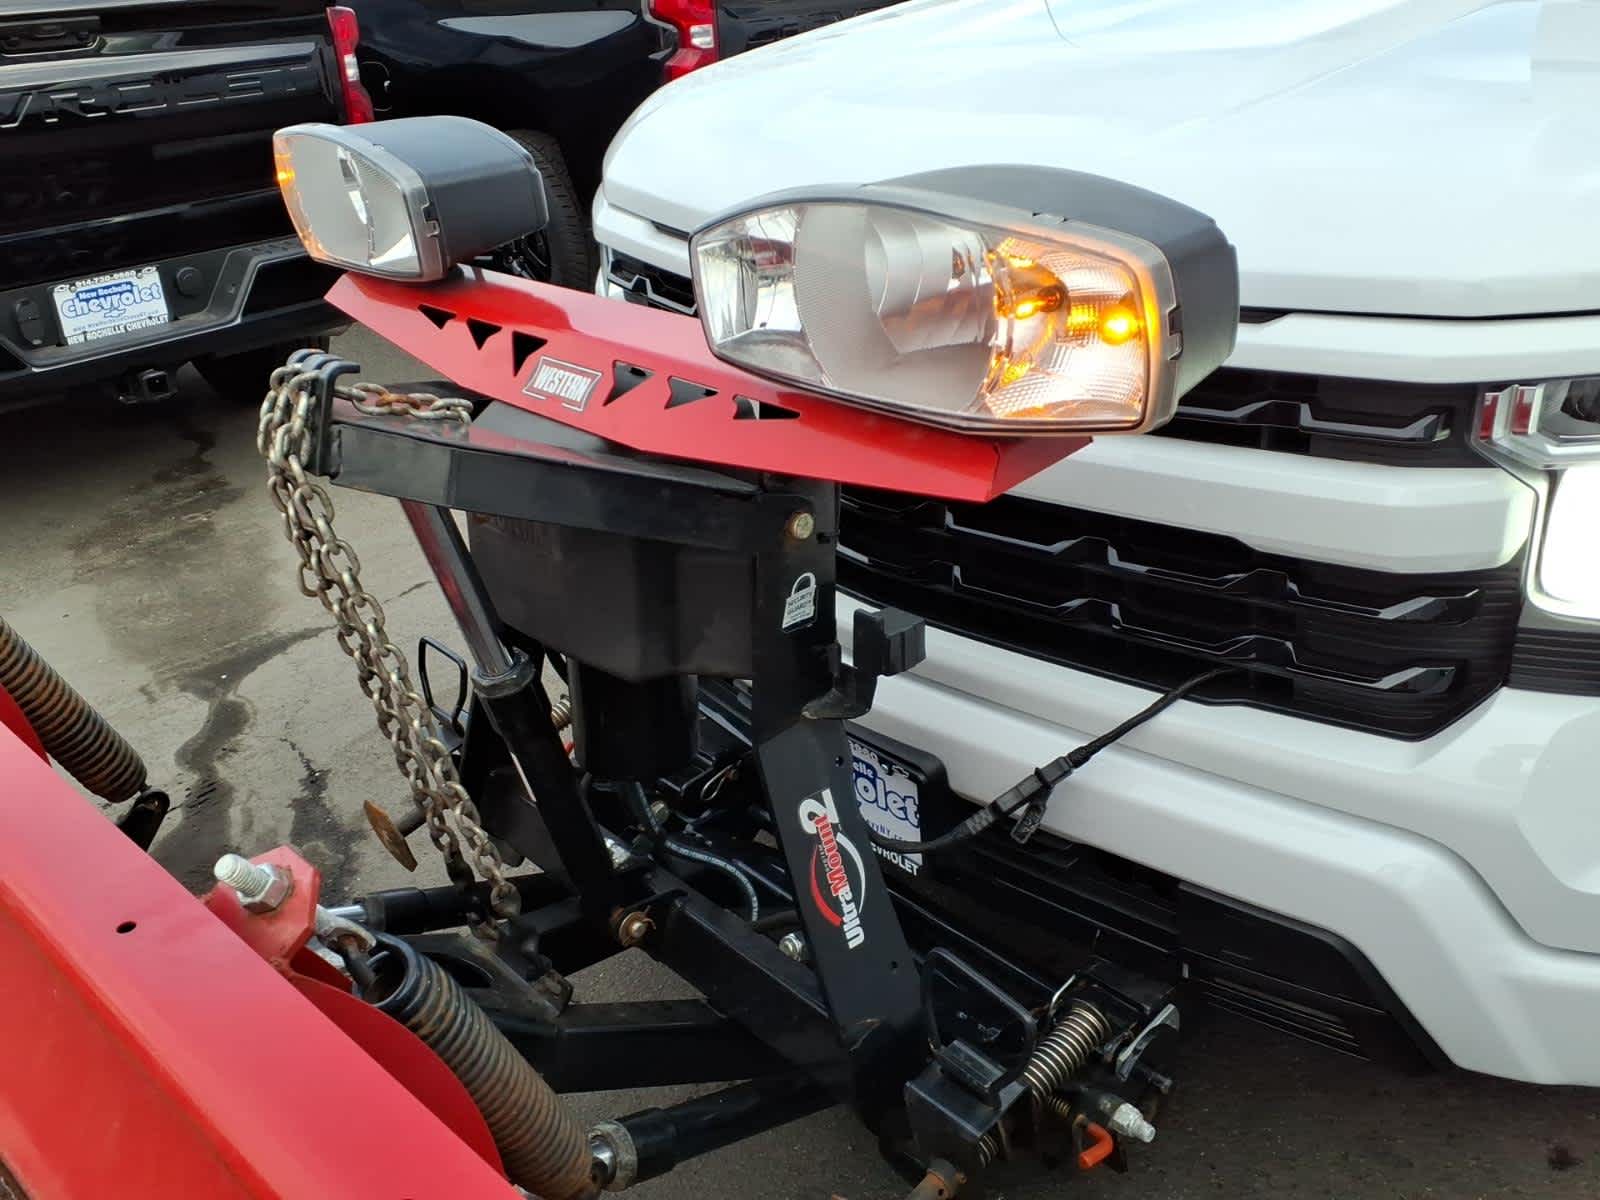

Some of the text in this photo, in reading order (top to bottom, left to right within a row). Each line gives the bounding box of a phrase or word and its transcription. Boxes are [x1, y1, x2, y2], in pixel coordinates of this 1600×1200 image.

[61, 281, 162, 319] Chevrolet
[78, 290, 98, 301] New
[67, 334, 86, 346] NEW
[86, 322, 126, 341] ROCHELLE
[126, 314, 169, 333] CHEVROLET
[533, 363, 592, 402] WESTERN
[798, 788, 840, 835] 2
[853, 773, 921, 829] olet
[814, 814, 866, 949] UltraMount
